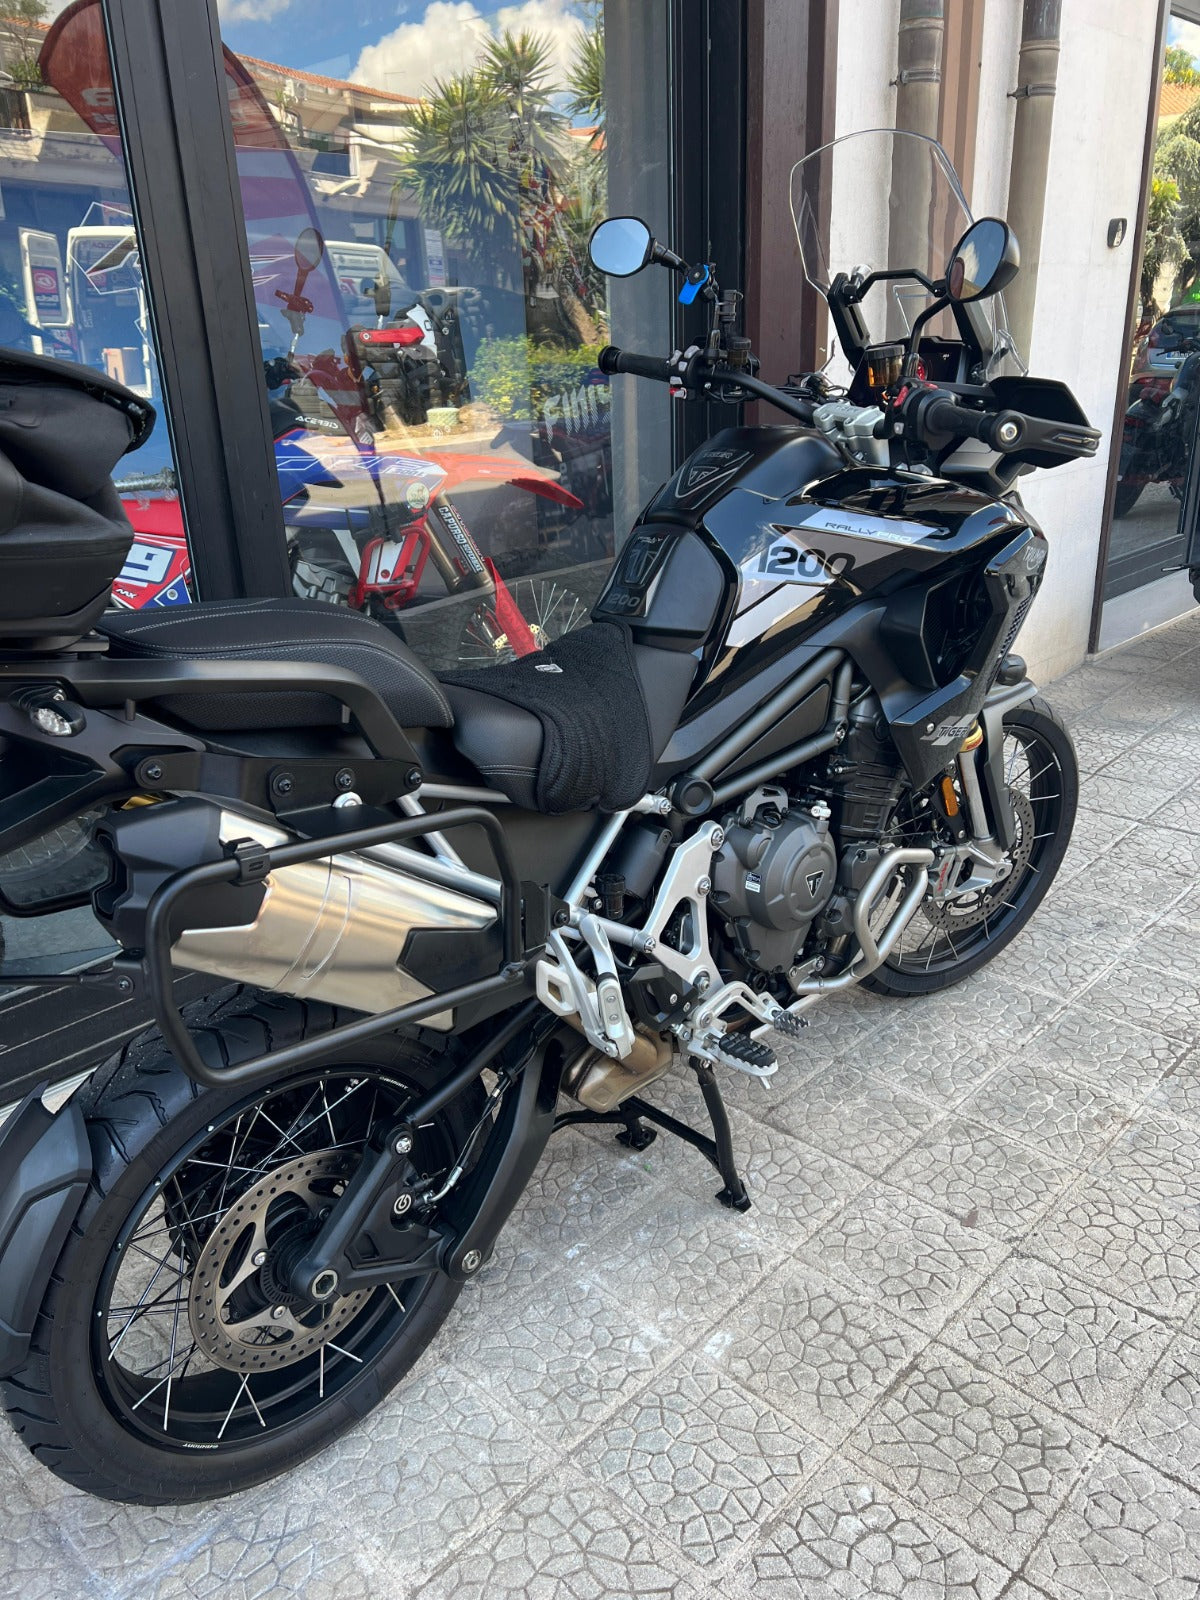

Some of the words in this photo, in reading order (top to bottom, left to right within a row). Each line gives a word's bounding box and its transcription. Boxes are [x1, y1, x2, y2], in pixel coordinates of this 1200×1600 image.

[438, 506, 468, 545] CAPURSO
[825, 522, 878, 536] RALLY
[757, 545, 857, 579] 1200
